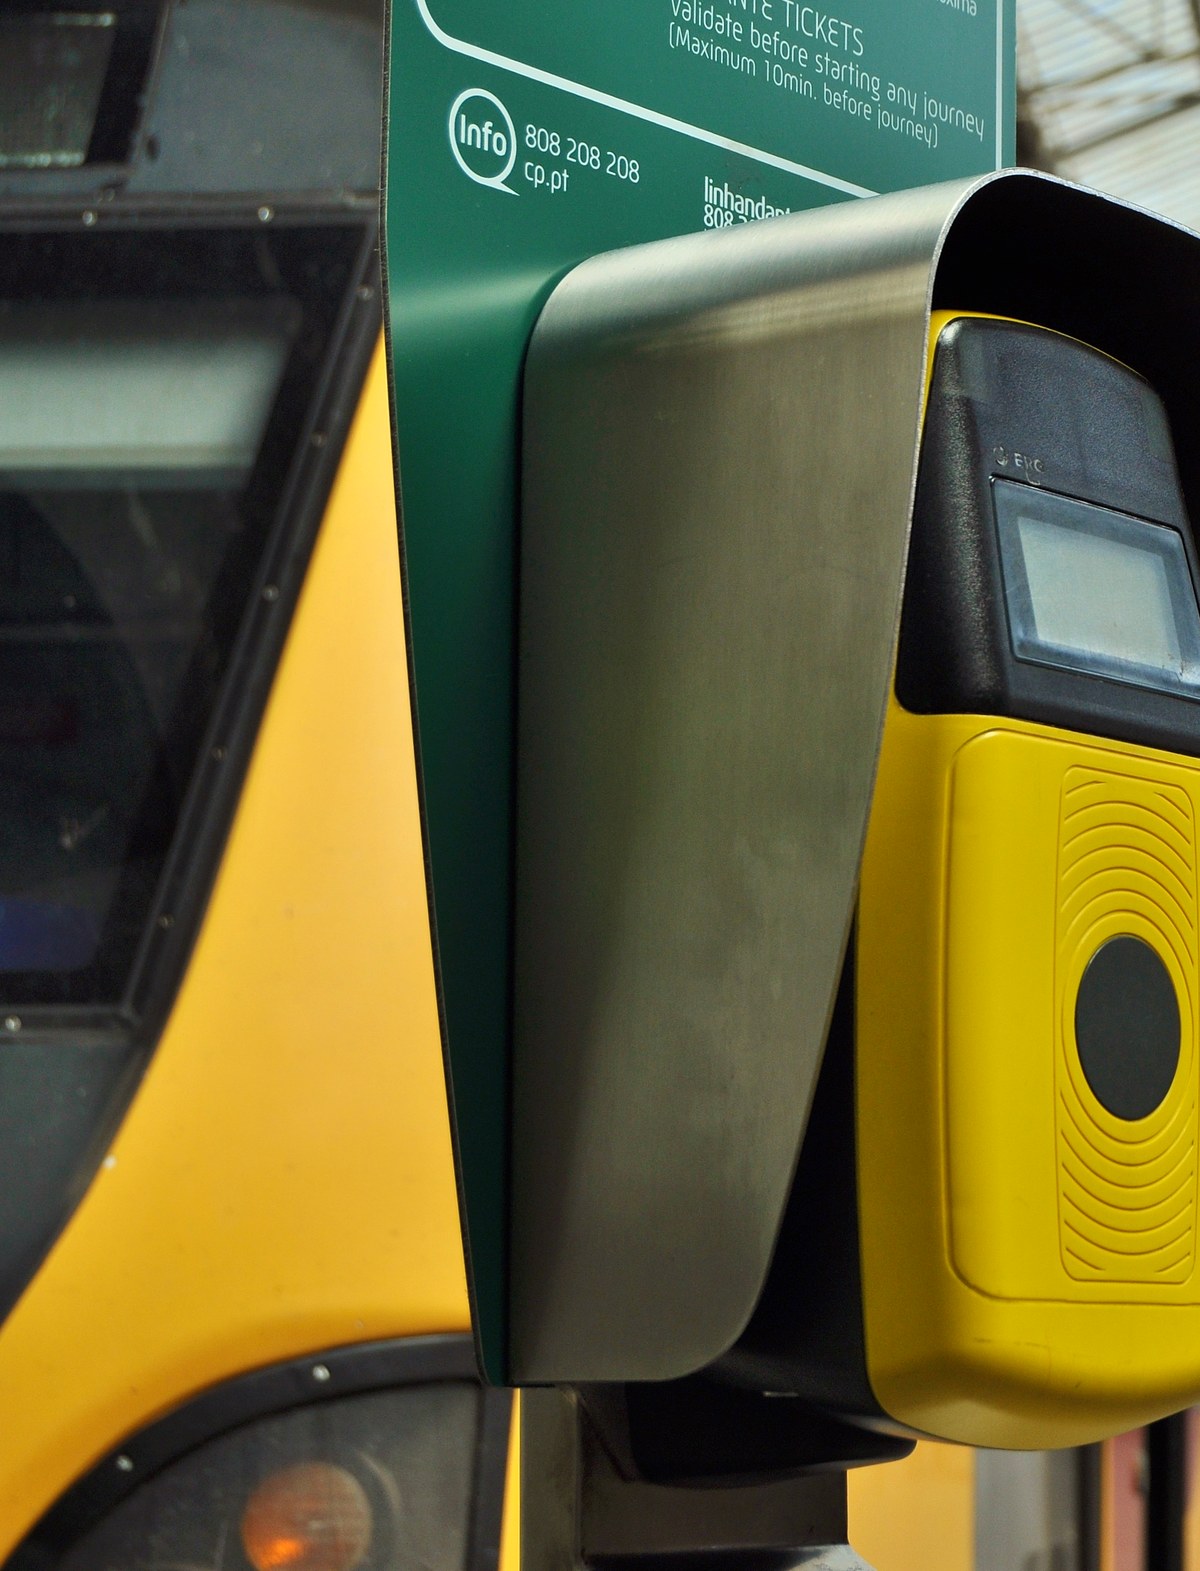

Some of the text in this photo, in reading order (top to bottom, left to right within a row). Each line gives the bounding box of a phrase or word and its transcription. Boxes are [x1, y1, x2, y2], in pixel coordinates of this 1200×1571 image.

[782, 0, 864, 56] TICKETS
[669, 21, 938, 149] (Maximum 10min. before journey)
[750, 21, 808, 68] before
[815, 52, 881, 102] starting
[887, 82, 917, 116] any
[923, 91, 985, 142] journey
[460, 114, 507, 156] Info
[525, 124, 640, 184] 808 208 208
[524, 161, 570, 194] cp.pt
